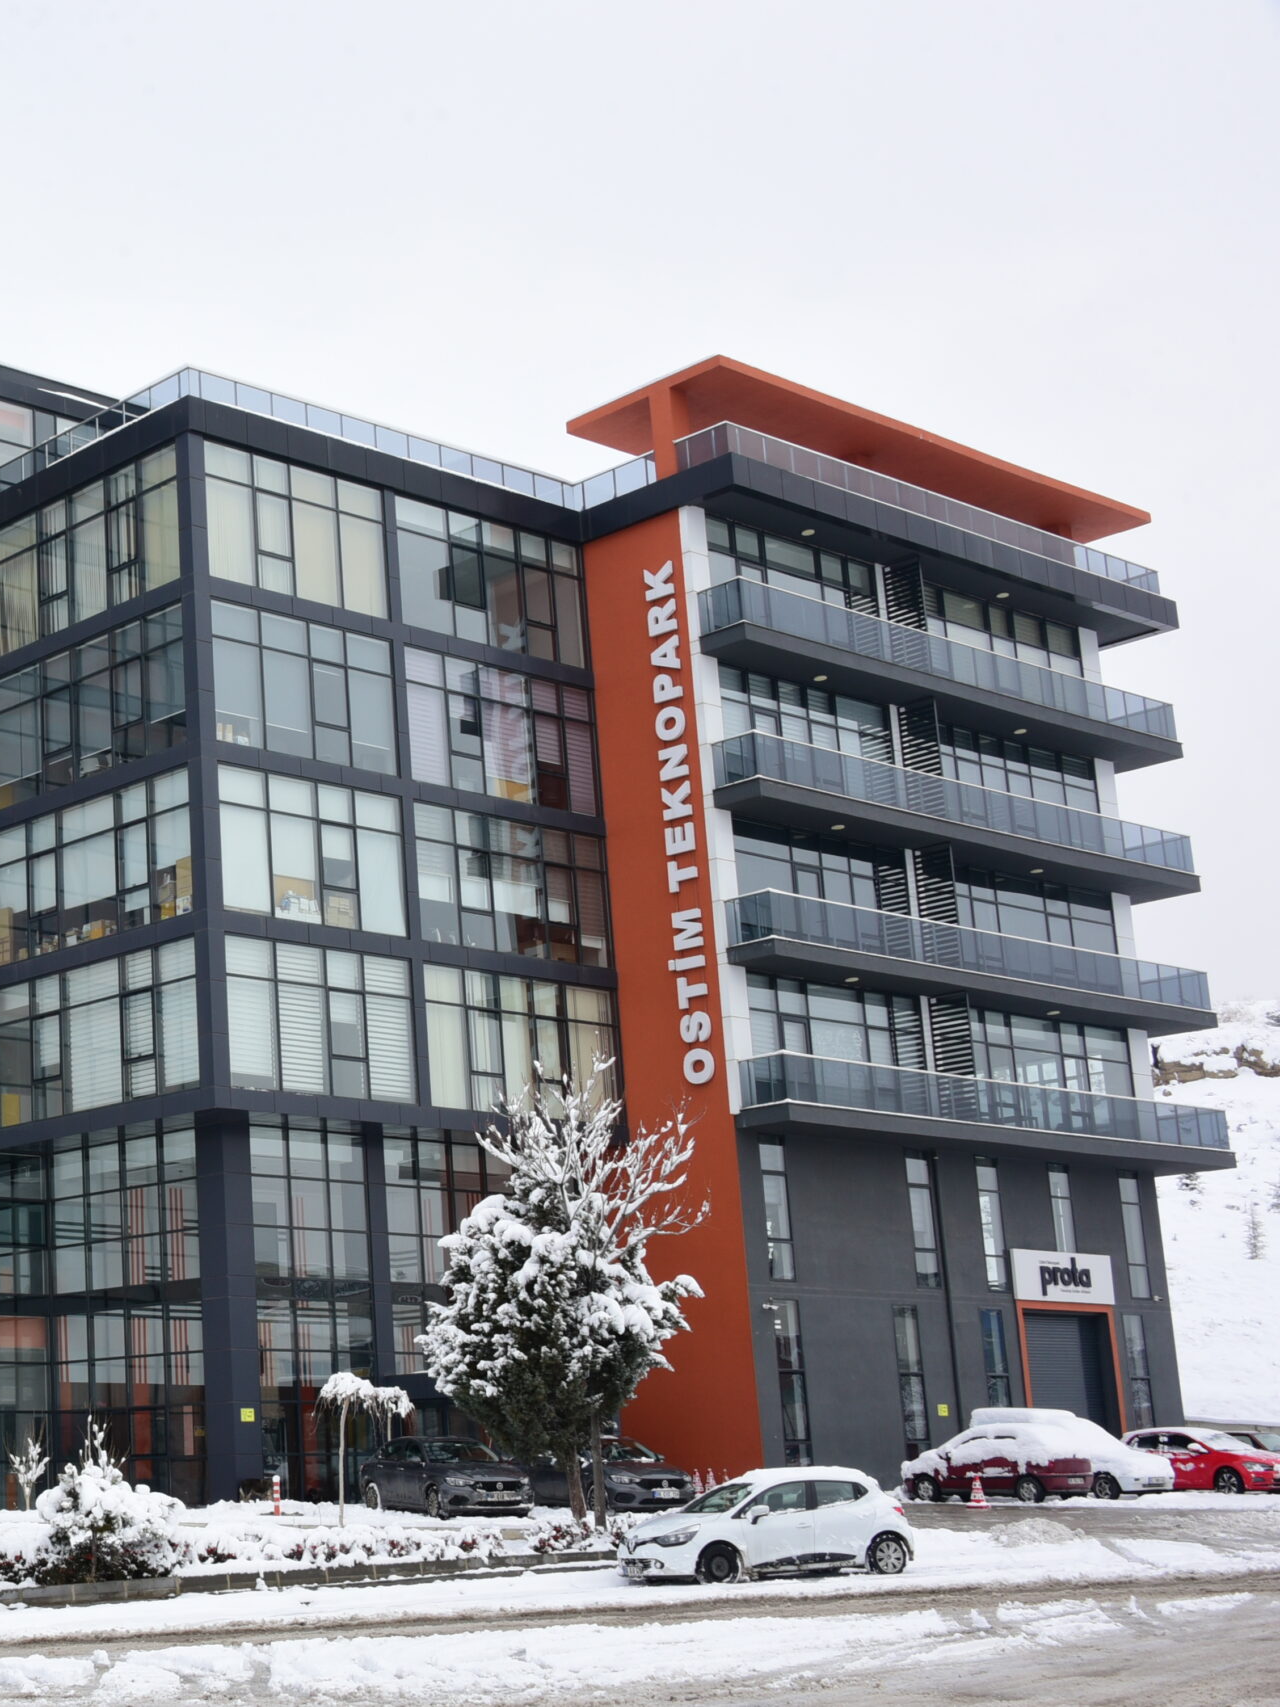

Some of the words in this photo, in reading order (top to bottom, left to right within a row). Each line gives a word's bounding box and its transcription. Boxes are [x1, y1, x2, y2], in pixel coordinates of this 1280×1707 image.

[642, 559, 699, 894] TEKNOPARK
[667, 907, 716, 1085] OSTİM
[1039, 1257, 1092, 1297] prota
